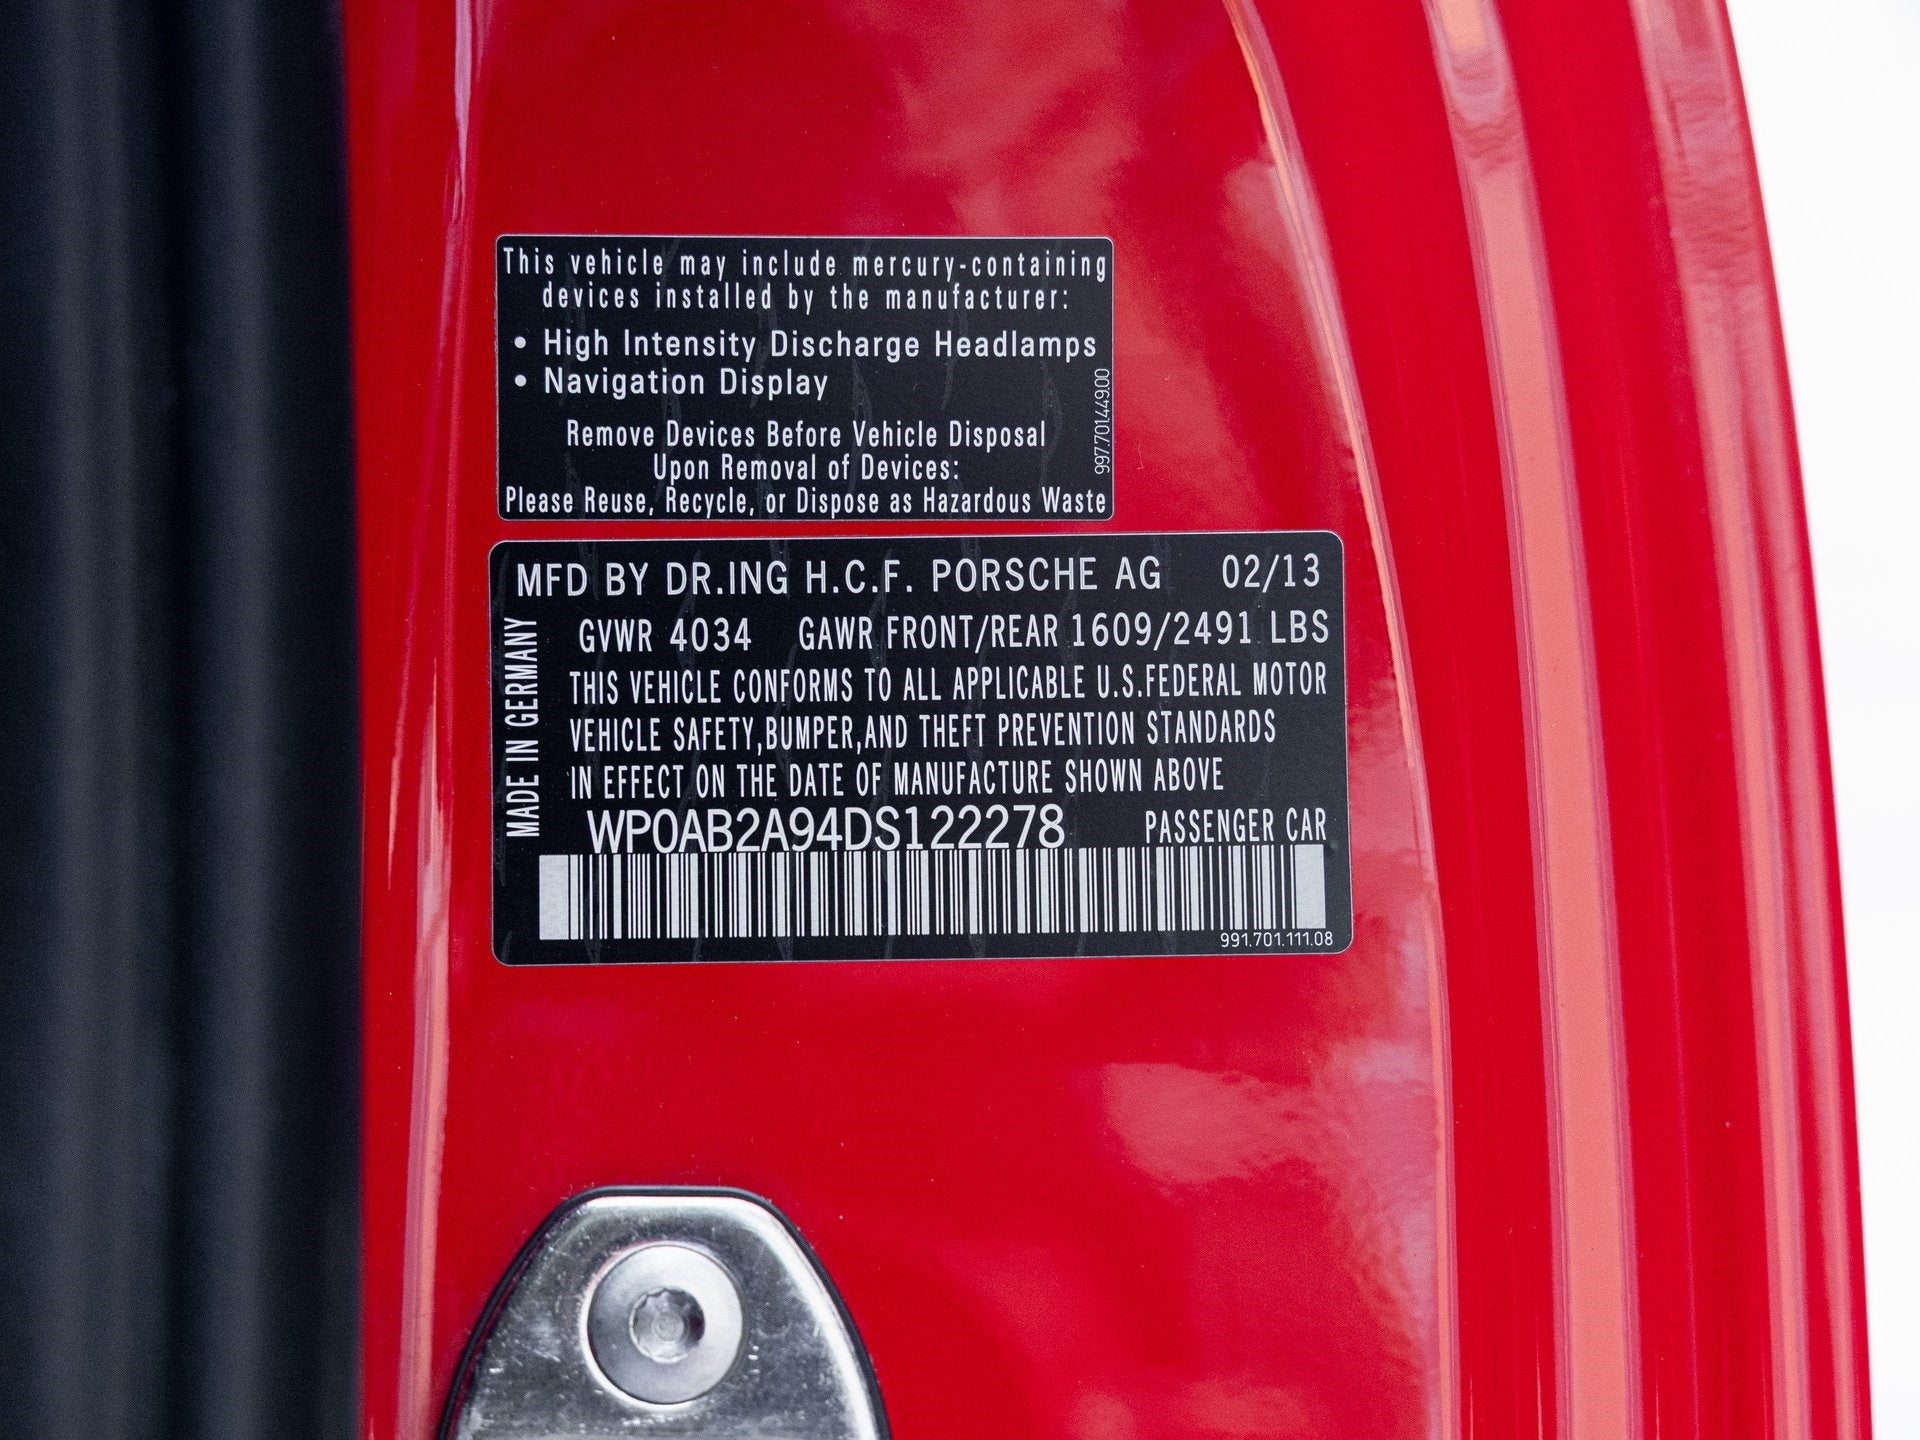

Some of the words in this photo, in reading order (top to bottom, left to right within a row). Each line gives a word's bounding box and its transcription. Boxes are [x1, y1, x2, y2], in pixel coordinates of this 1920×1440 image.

[504, 248, 553, 274] This
[571, 248, 662, 275] vehicle
[681, 255, 725, 281] may
[743, 249, 835, 276] include
[853, 250, 1105, 282] mercury-containing
[543, 281, 638, 308] devices
[657, 282, 770, 309] installed
[789, 283, 813, 315] by
[830, 283, 868, 309] the
[886, 283, 1067, 310] manufacturer:
[545, 329, 607, 361] High
[625, 329, 755, 362] Intensity
[772, 330, 919, 363] Discharge
[936, 330, 1096, 363] Headlamps
[545, 367, 703, 400] Navigation
[721, 368, 827, 401] Display
[568, 420, 653, 446] Remove
[667, 420, 754, 447] Devices
[768, 420, 840, 447] Before
[853, 420, 936, 447] Vehicle
[950, 420, 1045, 453] Disposal
[1094, 369, 1110, 474] 997.701.449.00
[654, 453, 708, 485] Upon
[722, 454, 815, 480] Removal
[829, 453, 849, 480] of
[862, 454, 958, 480] Devices:
[507, 486, 573, 513] Please
[585, 486, 653, 516] Reuse,
[666, 487, 754, 519] Recycle,
[767, 494, 785, 513] or
[798, 487, 878, 519] Dispose
[890, 493, 911, 513] as
[924, 487, 1030, 513] Hazardous
[1042, 487, 1105, 513] Waste
[518, 563, 587, 596] MFD
[607, 563, 648, 595] BY
[667, 561, 787, 595] DR.ING
[807, 560, 912, 593] H.C.F.
[933, 557, 1097, 592] PORSCHE
[1115, 556, 1160, 589] AG
[1223, 553, 1319, 593] 02/13
[580, 619, 652, 653] GVWR
[670, 618, 751, 652] 4034
[799, 616, 872, 650] GAWR
[888, 614, 1057, 653] FRONT/REAR
[1073, 611, 1251, 651] 1609/2491
[1271, 609, 1328, 643] LBS
[504, 618, 538, 726] GERMANY
[570, 670, 618, 704] THIS
[630, 670, 721, 704] VEHICLE
[734, 668, 852, 703] CONFORMS
[864, 667, 891, 701] TO
[903, 667, 941, 700] ALL
[953, 665, 1085, 700] APPLICABLE
[1098, 663, 1241, 698] U.S.FEDERAL
[1253, 661, 1326, 695] MOTOR
[570, 717, 660, 752] VEHICLE
[919, 714, 986, 747] THEFT
[999, 711, 1134, 746] PREVENTION
[1147, 708, 1275, 744] STANDARDS
[506, 740, 538, 761] IN
[572, 766, 591, 799] IN
[605, 765, 684, 799] EFFECT
[696, 764, 724, 798] ON
[737, 764, 777, 797] THE
[790, 763, 843, 796] DATE
[857, 762, 881, 796] OF
[895, 760, 1052, 795] MANUFACTURE
[1065, 758, 1141, 793] SHOWN
[1154, 757, 1223, 791] ABOVE
[506, 775, 539, 836] MADE
[1146, 808, 1274, 843] PASSENGER
[1286, 807, 1326, 841] CAR
[1220, 931, 1333, 948] 991.701.111.08
